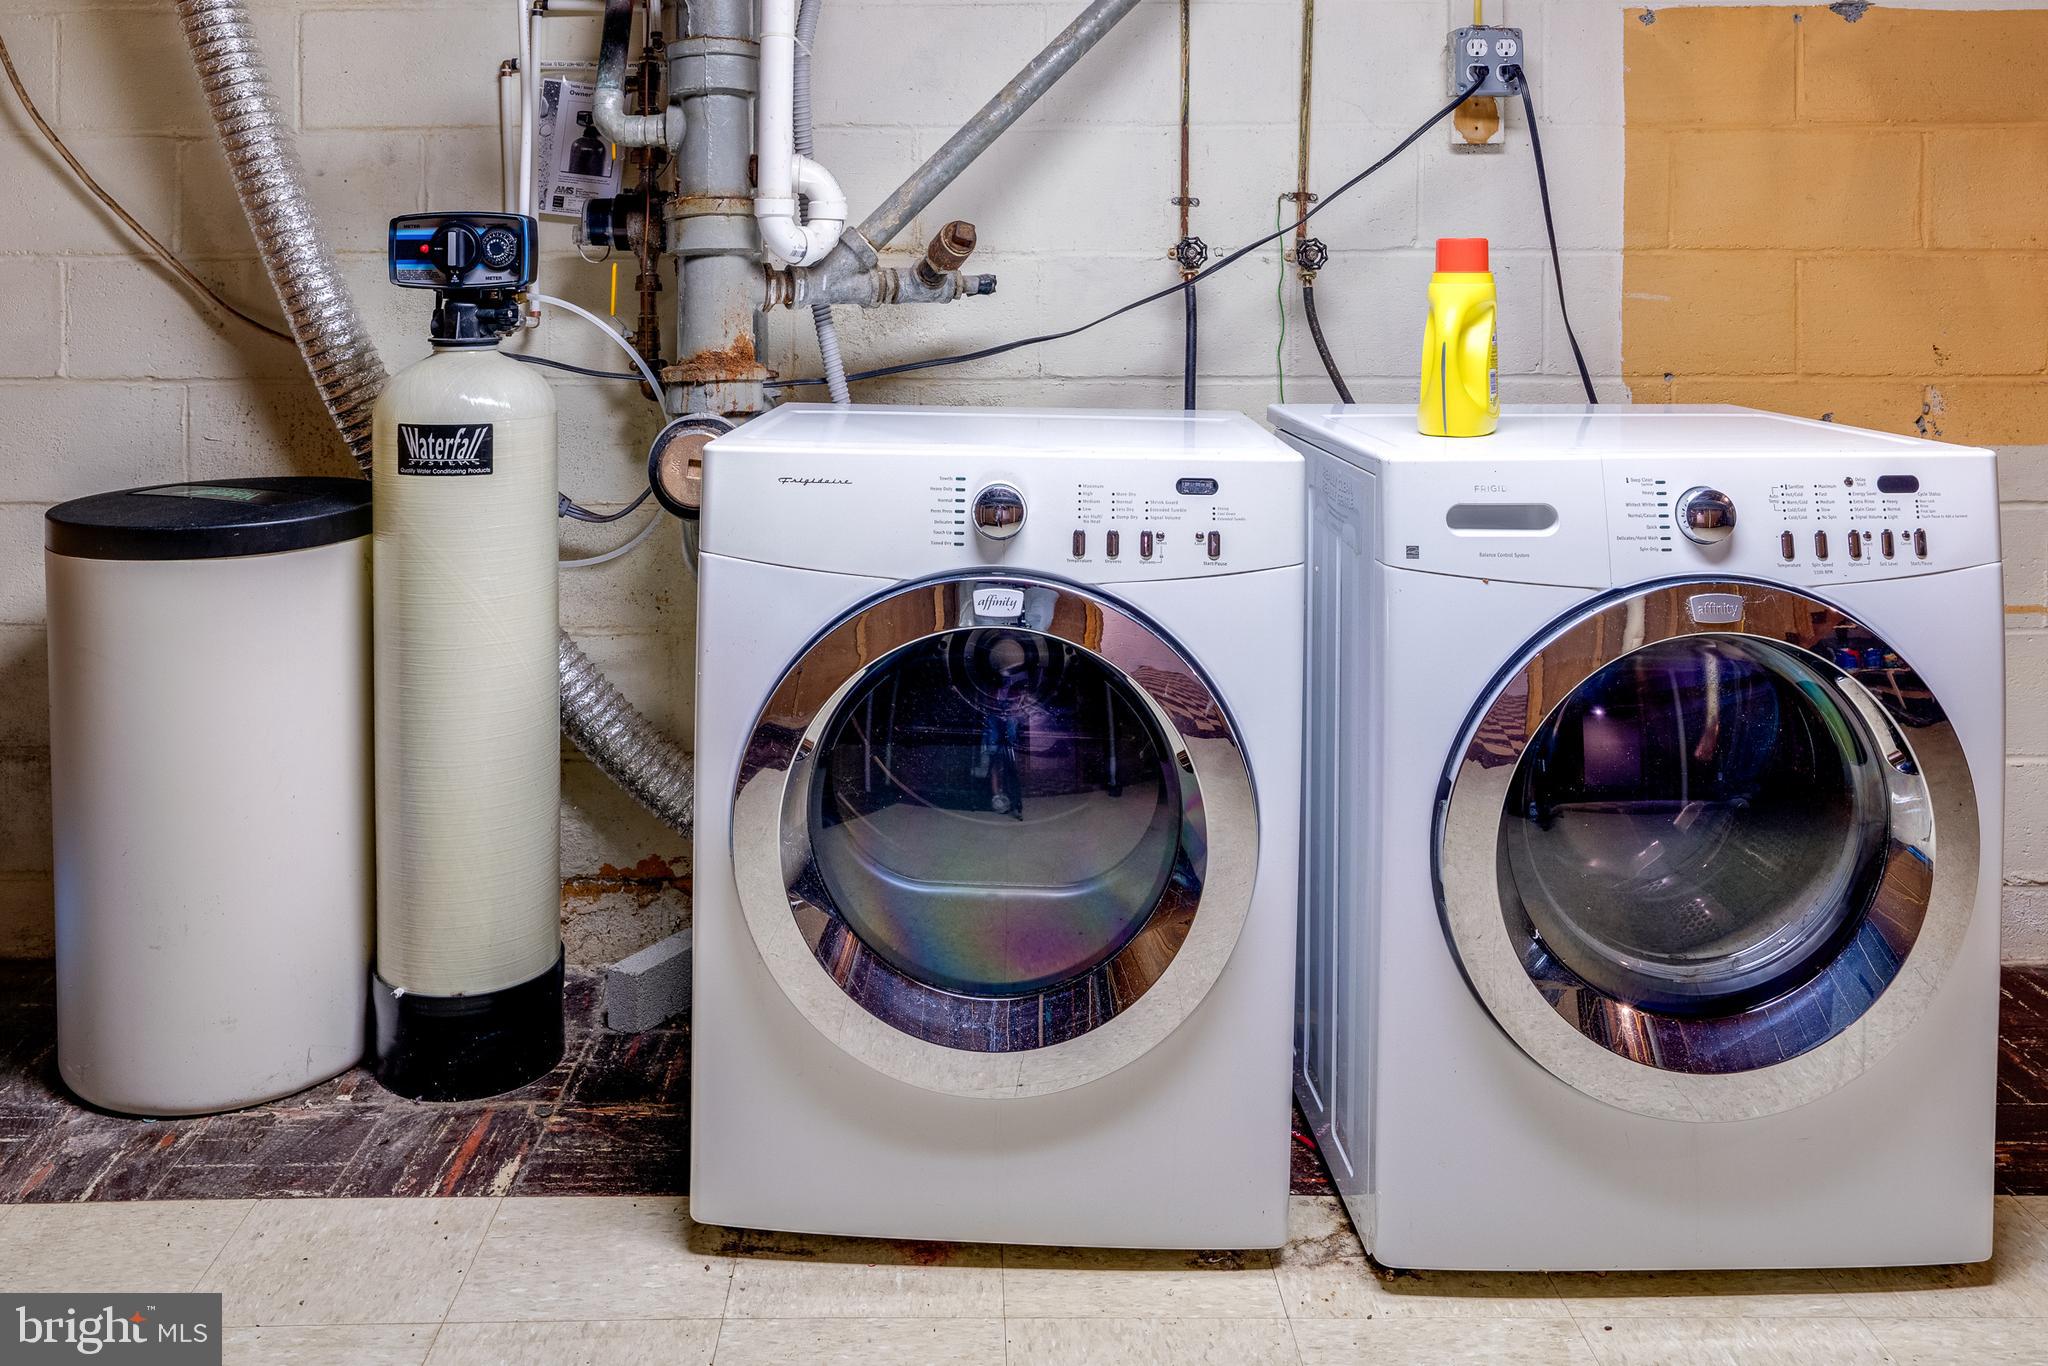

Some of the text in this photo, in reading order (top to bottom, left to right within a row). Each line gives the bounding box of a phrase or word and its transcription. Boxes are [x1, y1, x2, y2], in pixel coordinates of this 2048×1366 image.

[554, 185, 574, 195] AMS
[401, 426, 489, 460] Waterfall
[399, 467, 416, 475] Quality
[778, 477, 853, 486] Frigidaire
[977, 593, 1018, 611] affinity
[1697, 601, 1738, 617] affinity
